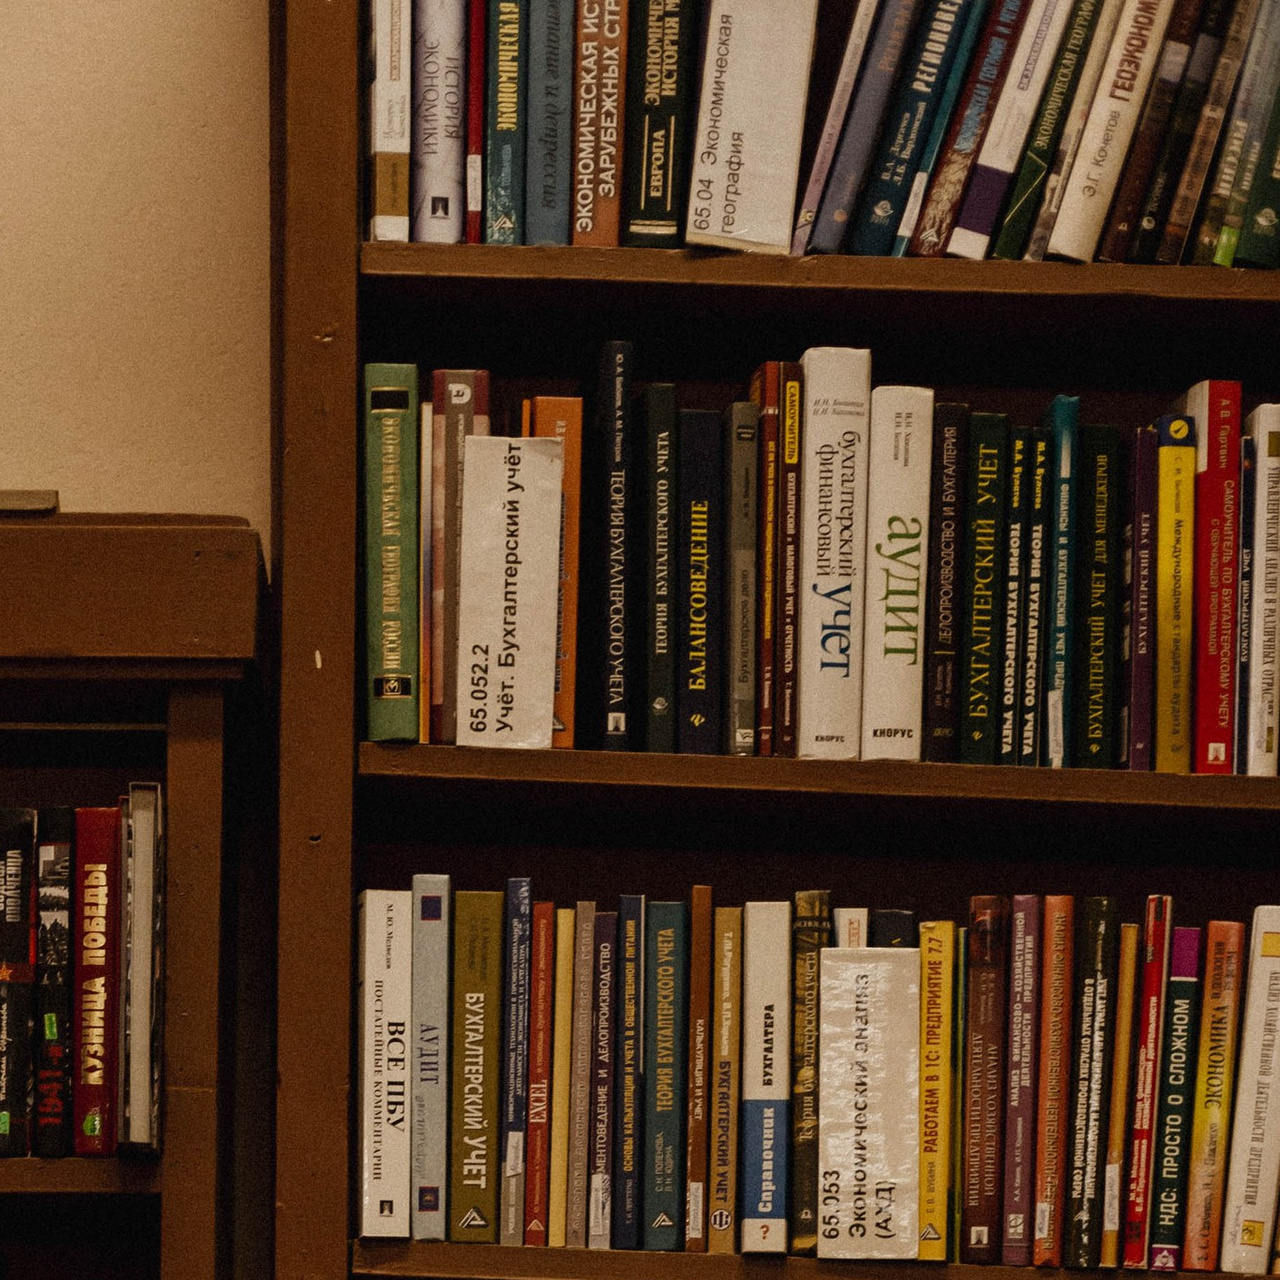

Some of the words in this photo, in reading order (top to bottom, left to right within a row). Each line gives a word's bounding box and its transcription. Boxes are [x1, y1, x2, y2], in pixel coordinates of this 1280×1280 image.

[422, 39, 439, 154] ЭКОНОМИКИ
[444, 56, 459, 139] ИСТОРИЯ
[598, 46, 621, 197] ЗАРУБЕЖНЫХ
[700, 13, 733, 165] Экономическая
[577, 41, 599, 232] ЭКОНОМИЧЕСКАЯ
[649, 129, 666, 197] ЕВРОПА
[693, 178, 715, 231] 65.04
[723, 132, 746, 234] география
[657, 431, 670, 473] УЧЕТА
[787, 385, 797, 460] САМОУЧИТЕЛЬ
[506, 443, 524, 492] учёт
[837, 430, 860, 577] бухгалтерский
[977, 444, 998, 504] УЧЕТ
[655, 479, 669, 595] БУХГАЛТЕРСКОГО
[815, 444, 839, 576] финансовый
[1029, 524, 1043, 578] ТЕОРИЯ
[1221, 480, 1235, 563] САМОУЧИТЕЛЬ
[499, 499, 521, 667] Бухгалтерский
[689, 500, 709, 690] БАЛАНСОВЕДЕНИЕ
[876, 515, 923, 665] аудит
[1221, 568, 1232, 583] ПО
[655, 604, 668, 654] ТЕОРИЯ
[812, 582, 853, 678] учет
[969, 519, 997, 717] БУХГАЛТЕРСКИЙ
[1024, 583, 1039, 706] БУХГАЛТЕРСКОГО
[1219, 588, 1231, 689] БУХГАЛТЕРСКОМУ
[470, 644, 489, 732] 65.052.2
[497, 675, 515, 732] Учёт.
[1218, 693, 1229, 727] УЧЕТУ
[873, 729, 913, 738] КНОРУС
[1022, 712, 1035, 755] УЧЕТА
[84, 863, 107, 965] ПОБЕДЫ
[928, 937, 943, 954] 7.7
[83, 977, 107, 1085] КУЗНИЦА
[925, 960, 943, 1045] ПРЕДПРИЯТИЕ
[1168, 998, 1190, 1085] СЛОЖНОМ
[386, 1021, 405, 1074] ВСЕ
[417, 1024, 439, 1085] АУДИТ
[464, 993, 489, 1129] БУХГАЛТЕРСКИЙ
[763, 1004, 776, 1086] БУХГАЛТЕРА
[387, 1081, 405, 1132] ПБУ
[530, 1079, 548, 1123] EXCEL
[922, 1088, 941, 1153] РАБОТАЕМ
[1168, 1094, 1183, 1105] О
[462, 1135, 486, 1189] УЧЕТ
[759, 1107, 777, 1212] Справочник
[1163, 1114, 1183, 1179] ПРОСТО
[1160, 1187, 1179, 1225] НДС:
